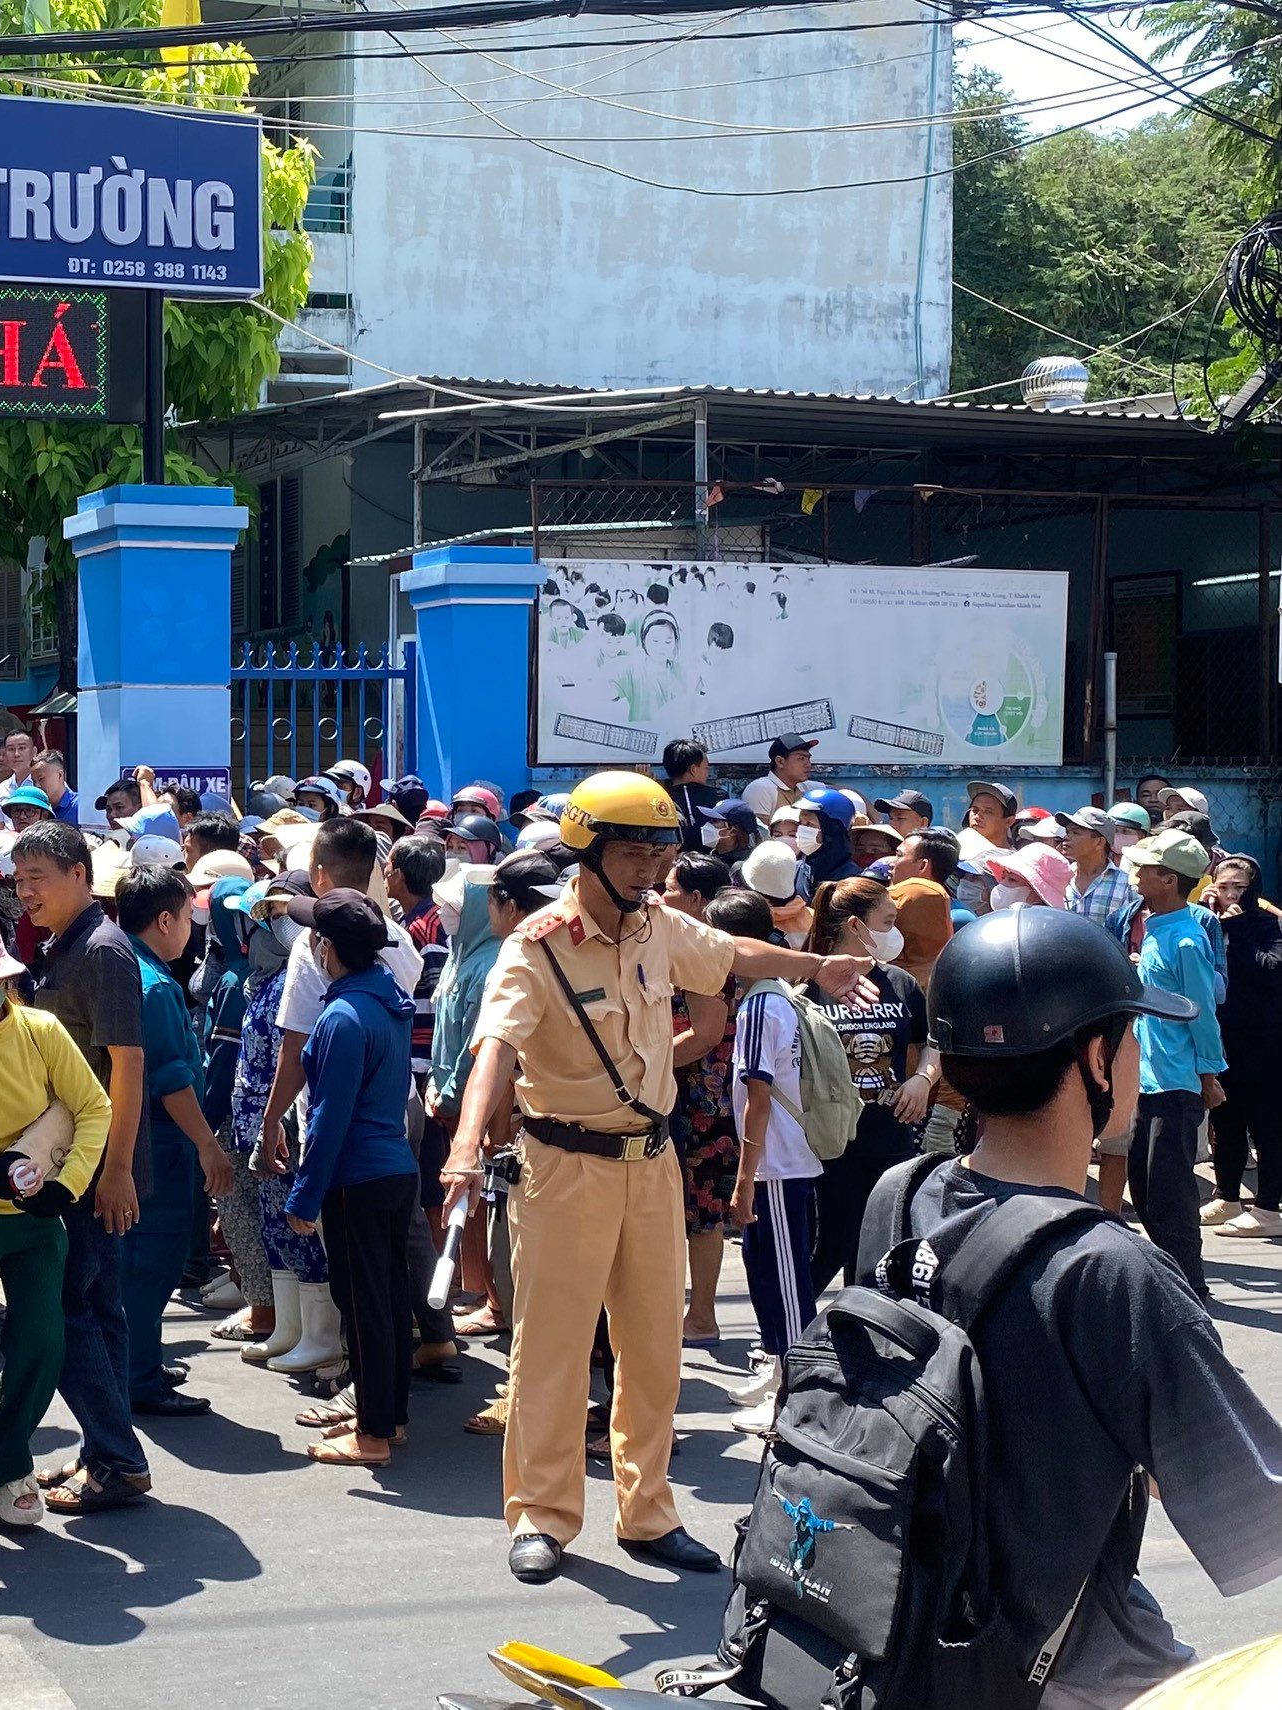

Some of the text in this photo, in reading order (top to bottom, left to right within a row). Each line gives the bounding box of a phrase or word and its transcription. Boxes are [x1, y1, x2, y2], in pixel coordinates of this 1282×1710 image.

[68, 256, 228, 281] ĐT: 0258 388 1143
[206, 777, 226, 792] XE
[864, 1021, 897, 1030] ENGLAND
